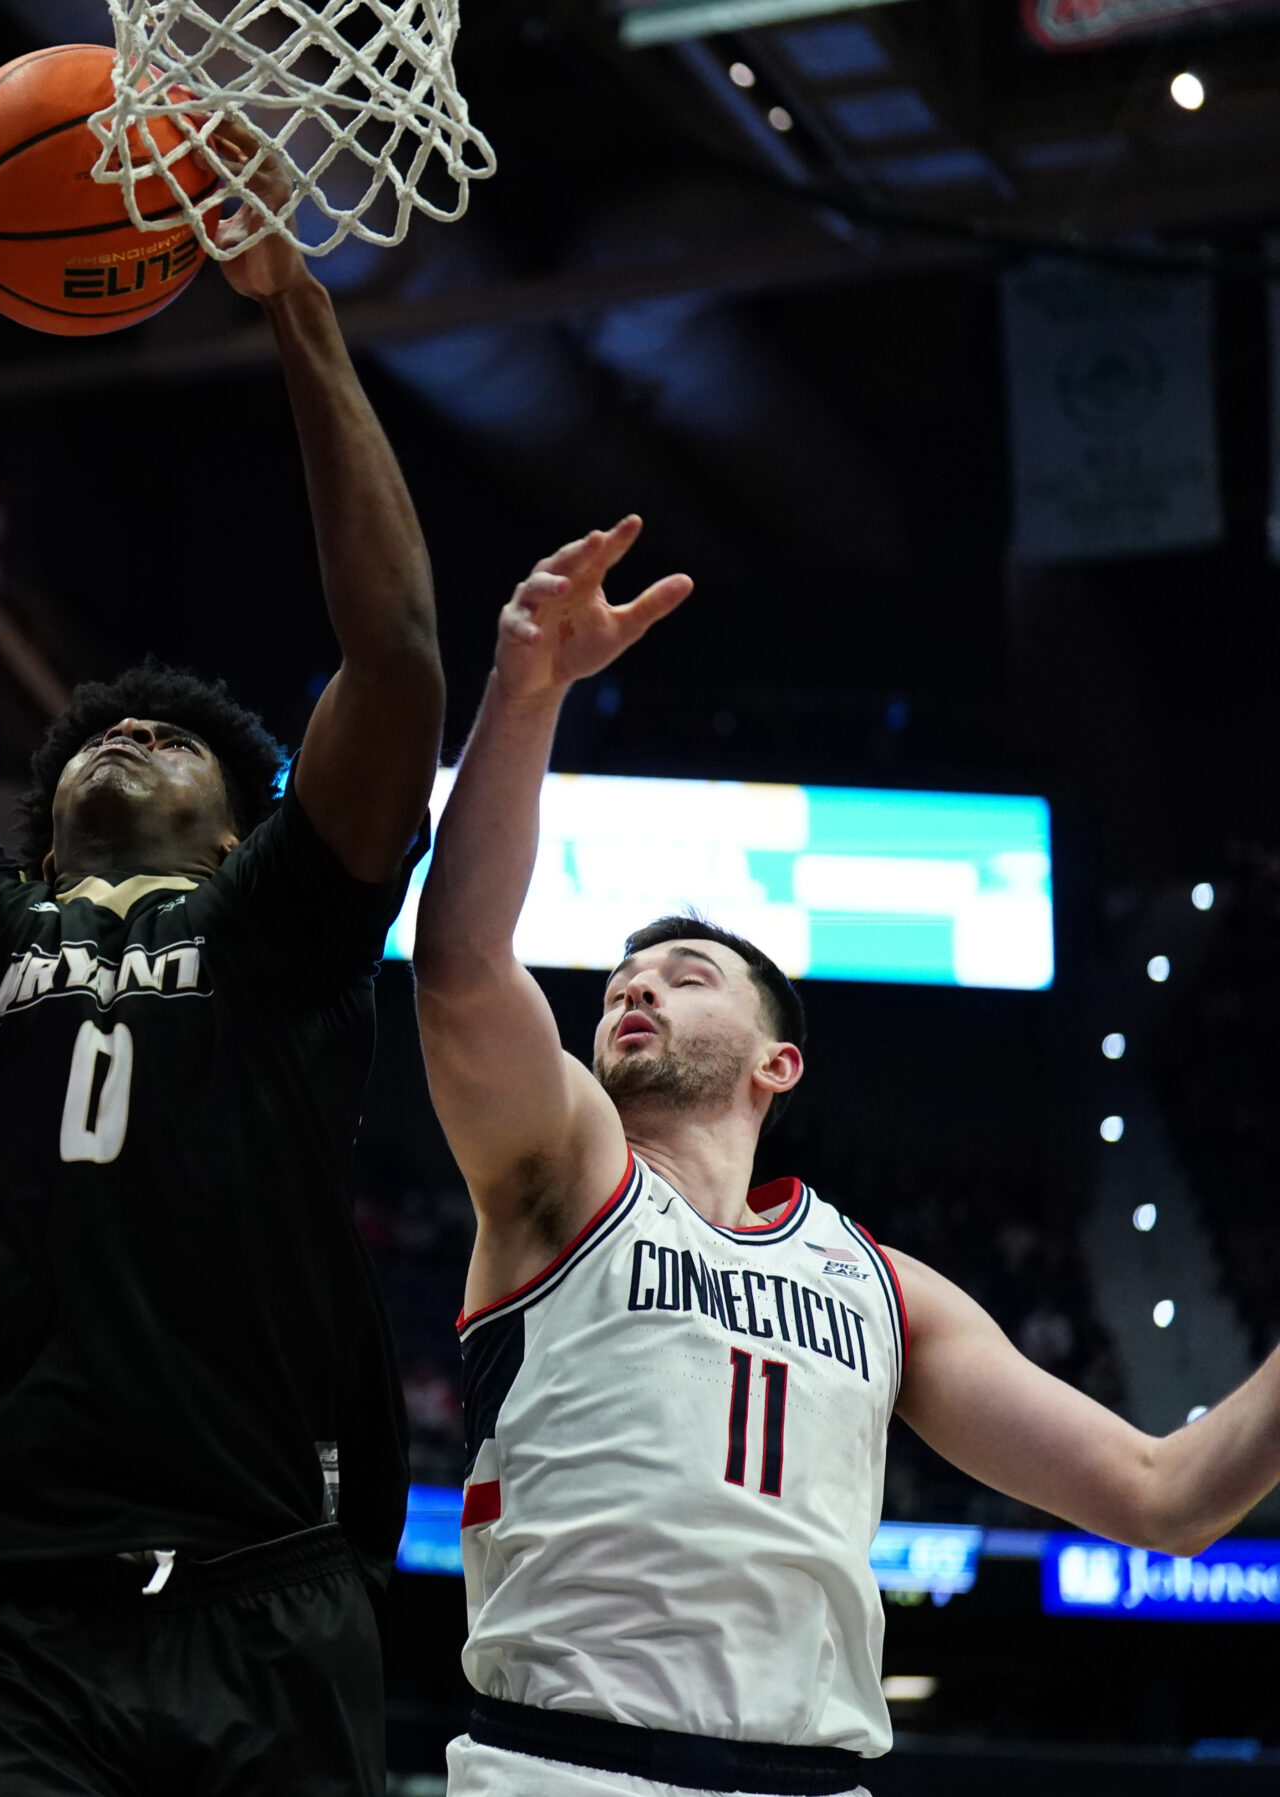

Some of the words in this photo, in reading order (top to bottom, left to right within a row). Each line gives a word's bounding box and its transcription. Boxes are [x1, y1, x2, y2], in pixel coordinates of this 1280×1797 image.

[63, 235, 199, 298] ELITE
[59, 1019, 134, 1165] 0
[628, 1240, 870, 1382] CONNECTICUT
[824, 1266, 870, 1280] EAST
[825, 1261, 858, 1271] BIG
[724, 1346, 788, 1498] 11
